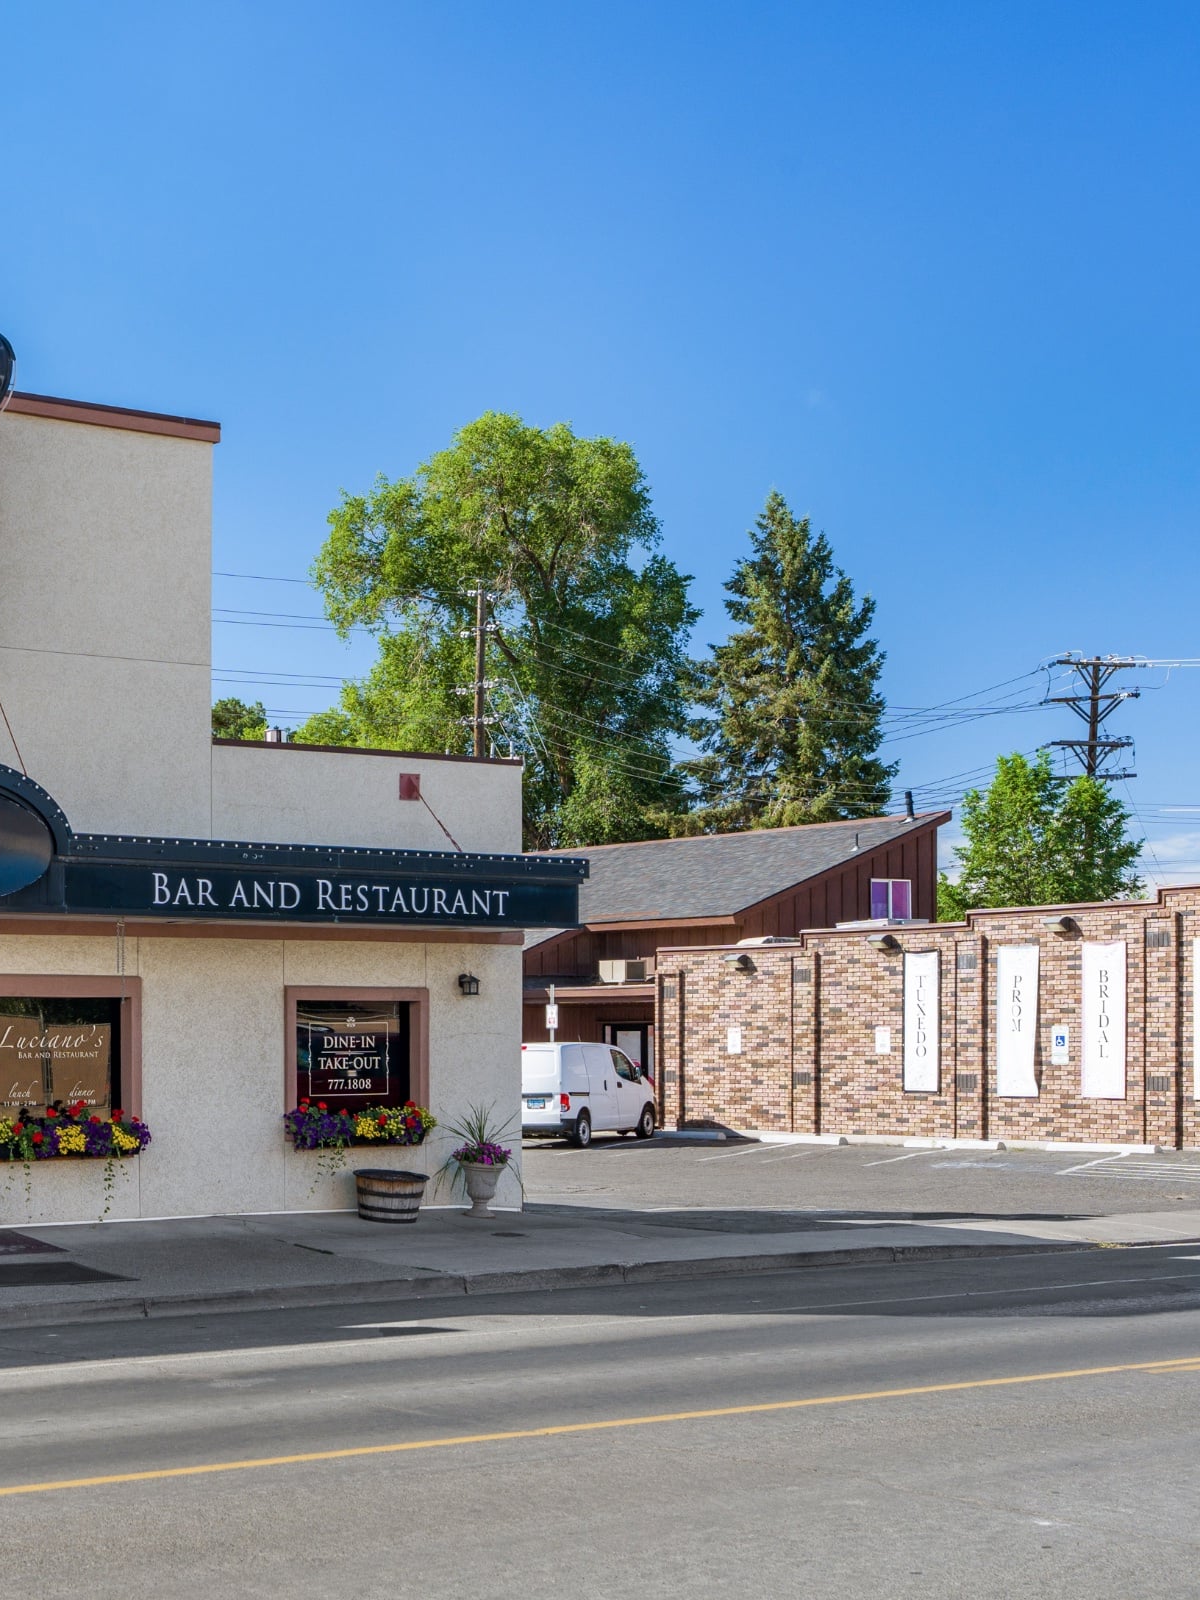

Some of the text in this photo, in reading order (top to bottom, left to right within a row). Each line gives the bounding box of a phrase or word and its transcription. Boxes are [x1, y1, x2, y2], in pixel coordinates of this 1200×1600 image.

[152, 872, 510, 917] BAR AND RESTAURANT
[1011, 974, 1023, 1033] PROM
[915, 974, 928, 1058] TUXEDO
[1098, 969, 1110, 1058] BRIDAL
[323, 1035, 376, 1049] DINE-IN
[18, 1051, 99, 1059] BAR AND RESTAURANT
[318, 1056, 381, 1070] TAKE-OUT
[8, 1080, 39, 1098] lunch
[69, 1080, 96, 1097] dinner
[327, 1078, 372, 1090] 777.1808
